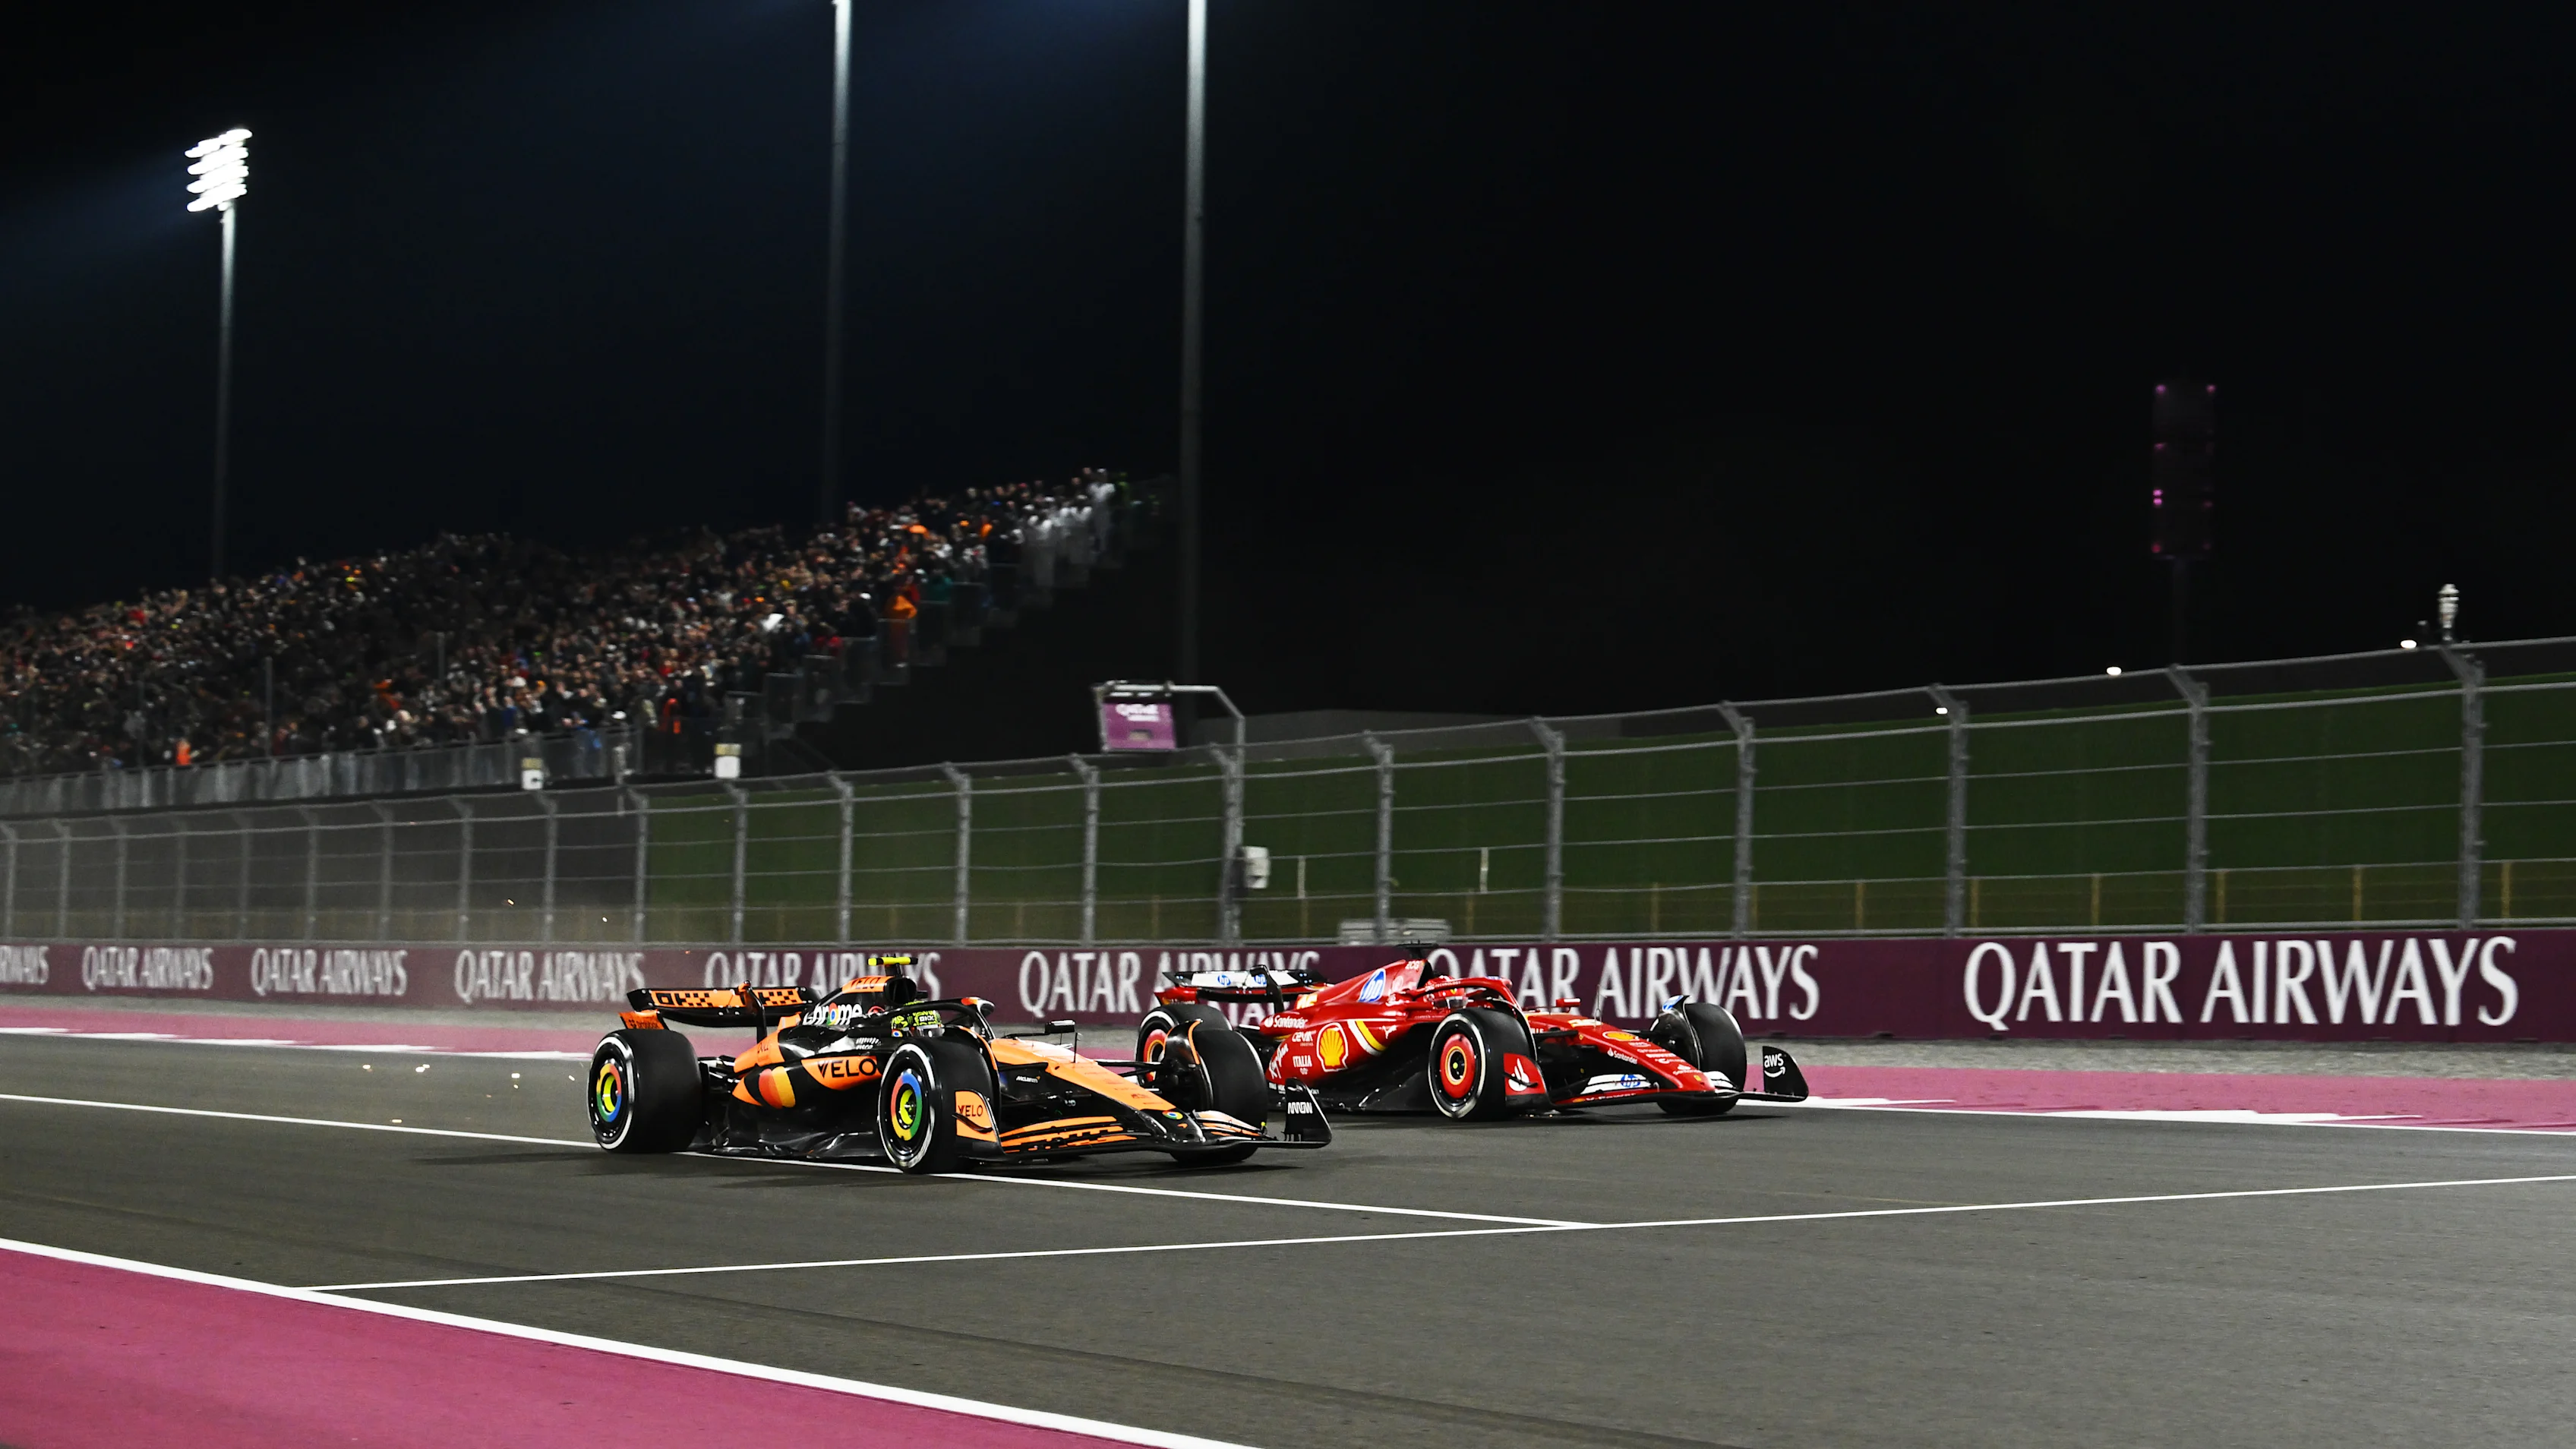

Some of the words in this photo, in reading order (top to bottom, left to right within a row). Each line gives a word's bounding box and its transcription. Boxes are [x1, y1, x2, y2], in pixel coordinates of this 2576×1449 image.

[455, 949, 533, 1003] QATAR
[535, 952, 646, 1002] AIRWAYS
[1217, 974, 1231, 987] hp
[1018, 950, 1141, 1018] QATAR
[1963, 941, 2183, 1032] QATAR
[2199, 936, 2521, 1027] AIRWAYS
[1274, 1015, 1308, 1028] Santander
[1293, 1055, 1312, 1067] ITALIA
[1614, 1050, 1638, 1065] Santander
[1764, 1053, 1784, 1068] aws
[817, 1058, 879, 1078] VELO
[958, 1105, 983, 1117] VELO
[1287, 1102, 1313, 1114] ARROW
